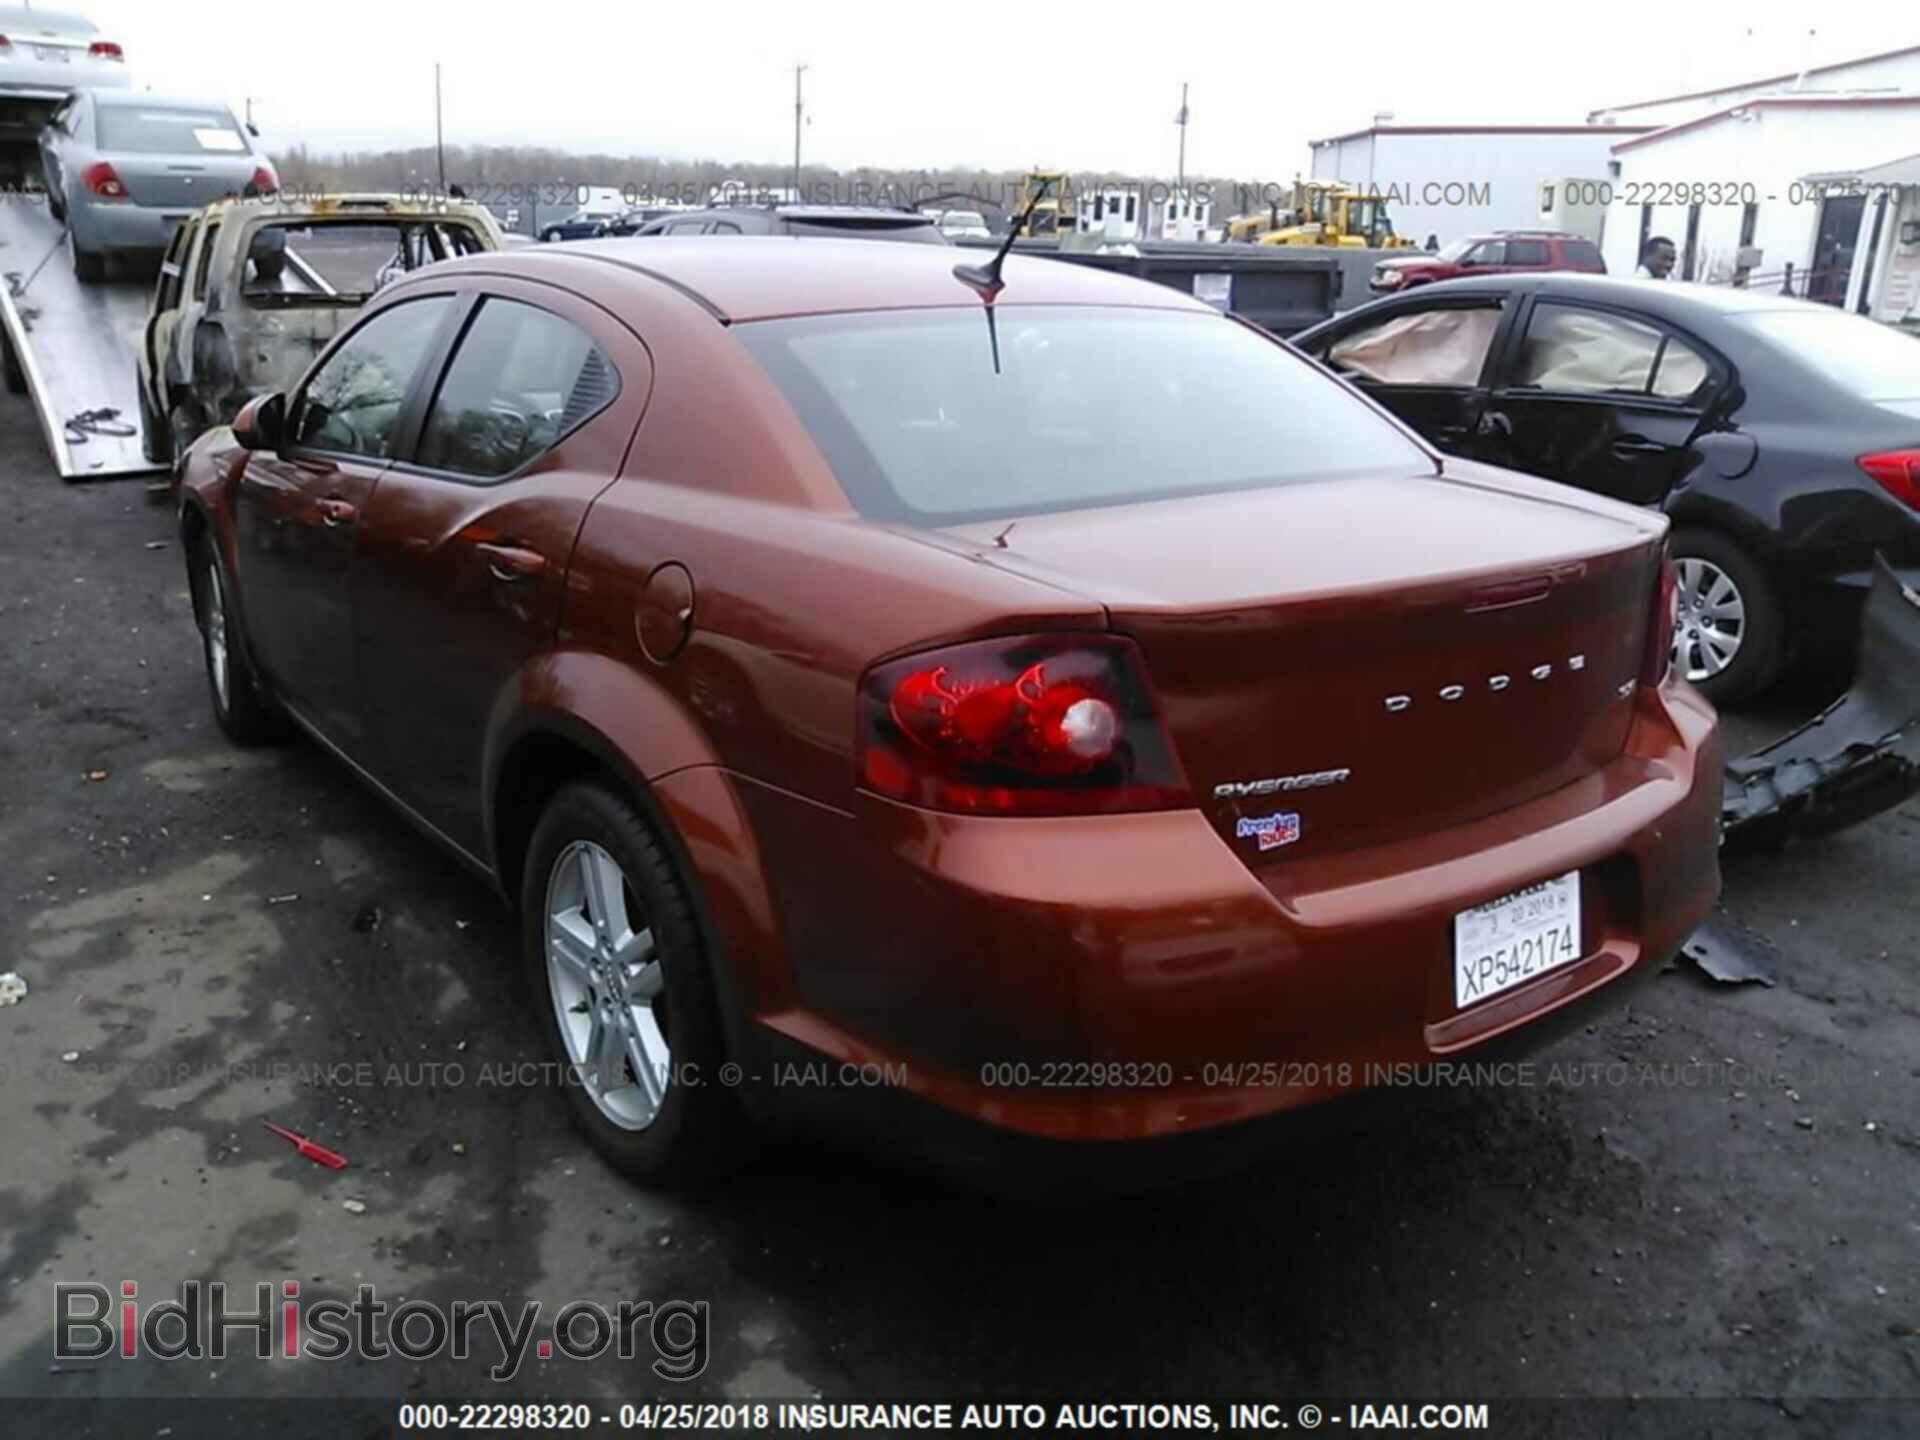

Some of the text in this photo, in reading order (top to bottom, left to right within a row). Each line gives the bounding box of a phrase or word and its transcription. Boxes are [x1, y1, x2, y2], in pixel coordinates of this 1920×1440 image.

[1385, 655, 1583, 711] DODGE
[1214, 768, 1350, 797] AVENGER
[1462, 922, 1574, 1001] XP542174
